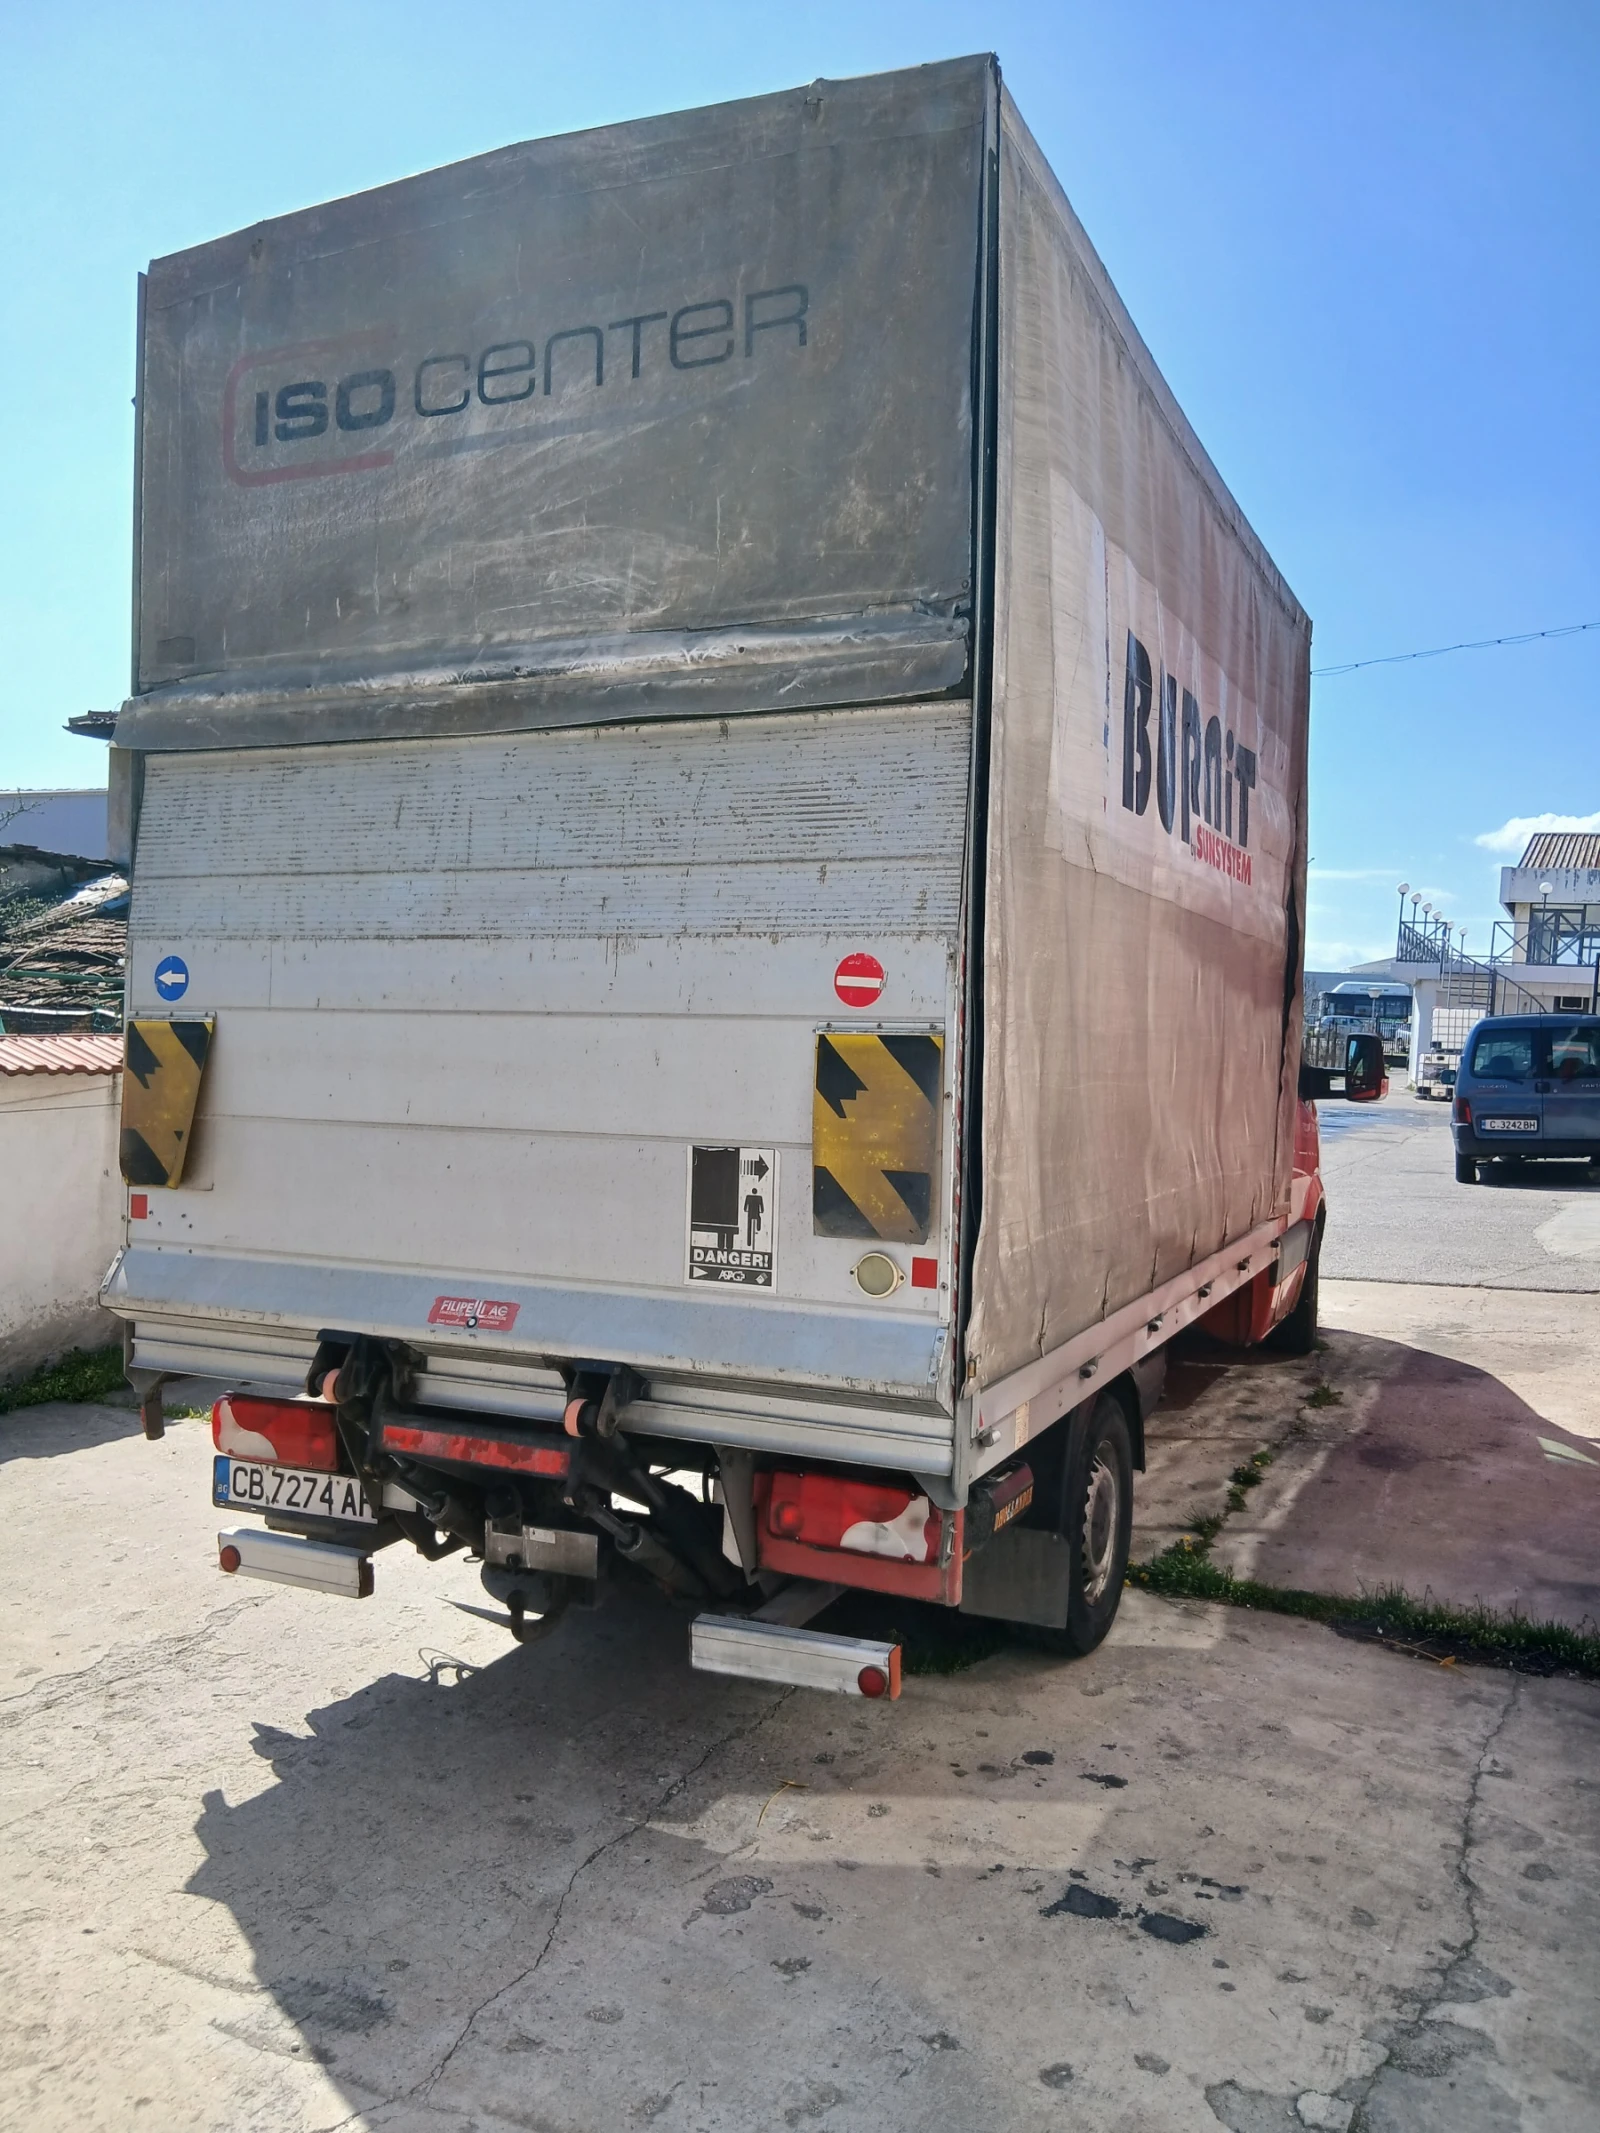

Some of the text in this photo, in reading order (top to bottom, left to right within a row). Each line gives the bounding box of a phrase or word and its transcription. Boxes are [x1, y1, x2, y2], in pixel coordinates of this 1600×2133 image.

[254, 367, 396, 447] ISO
[1197, 823, 1252, 886] SUNSYSTEM
[693, 1248, 769, 1269] DANGER!
[488, 1305, 509, 1317] AG
[216, 1483, 228, 1493] BG
[232, 1465, 264, 1501] CB
[270, 1471, 334, 1515] 7274
